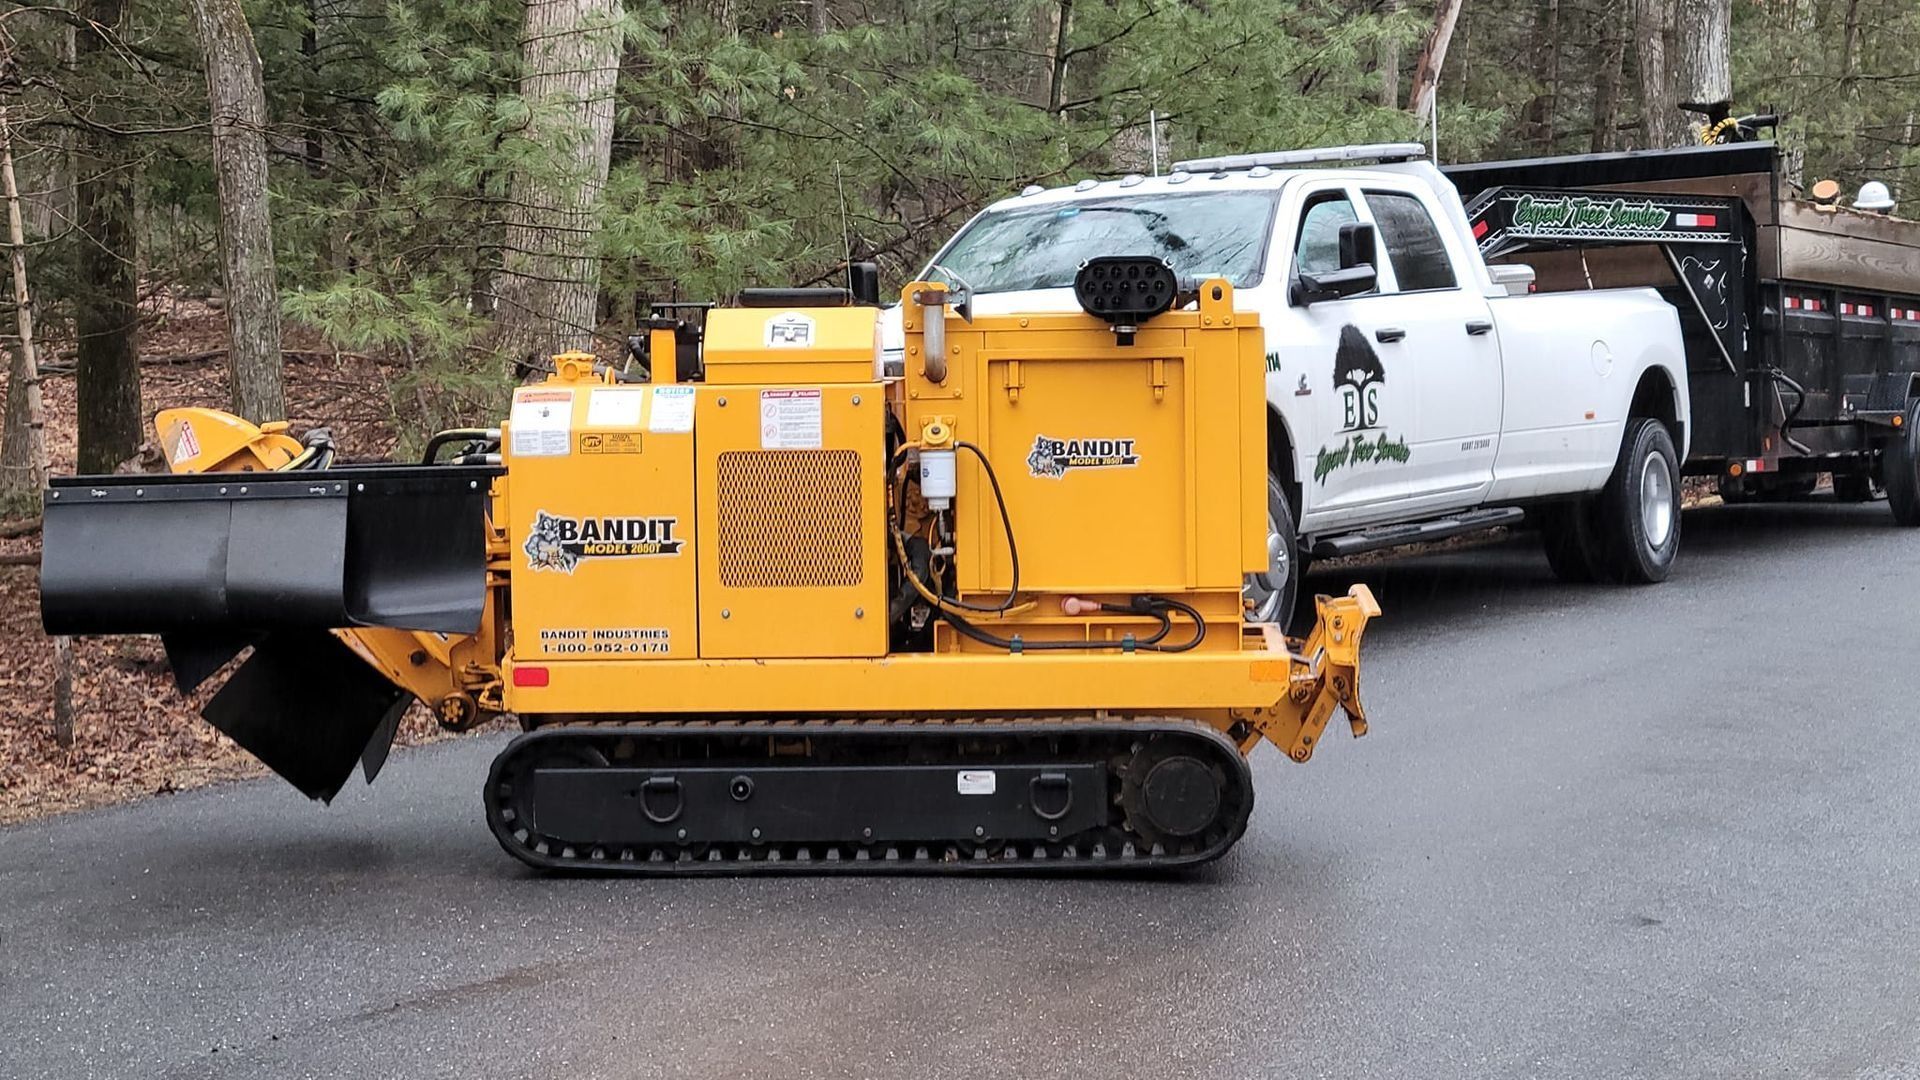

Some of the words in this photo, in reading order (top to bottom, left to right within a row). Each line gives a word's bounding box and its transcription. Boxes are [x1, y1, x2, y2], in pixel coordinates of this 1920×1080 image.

[1571, 196, 1608, 230] Tree
[1051, 440, 1134, 456] BANDIT
[1069, 457, 1100, 466] MODEL
[559, 519, 676, 541] BANDIT
[583, 543, 628, 554] MODEL
[541, 630, 588, 640] BANDIT
[592, 630, 669, 640] INDUSTRIES
[542, 642, 669, 654] 1-800-952-0178
